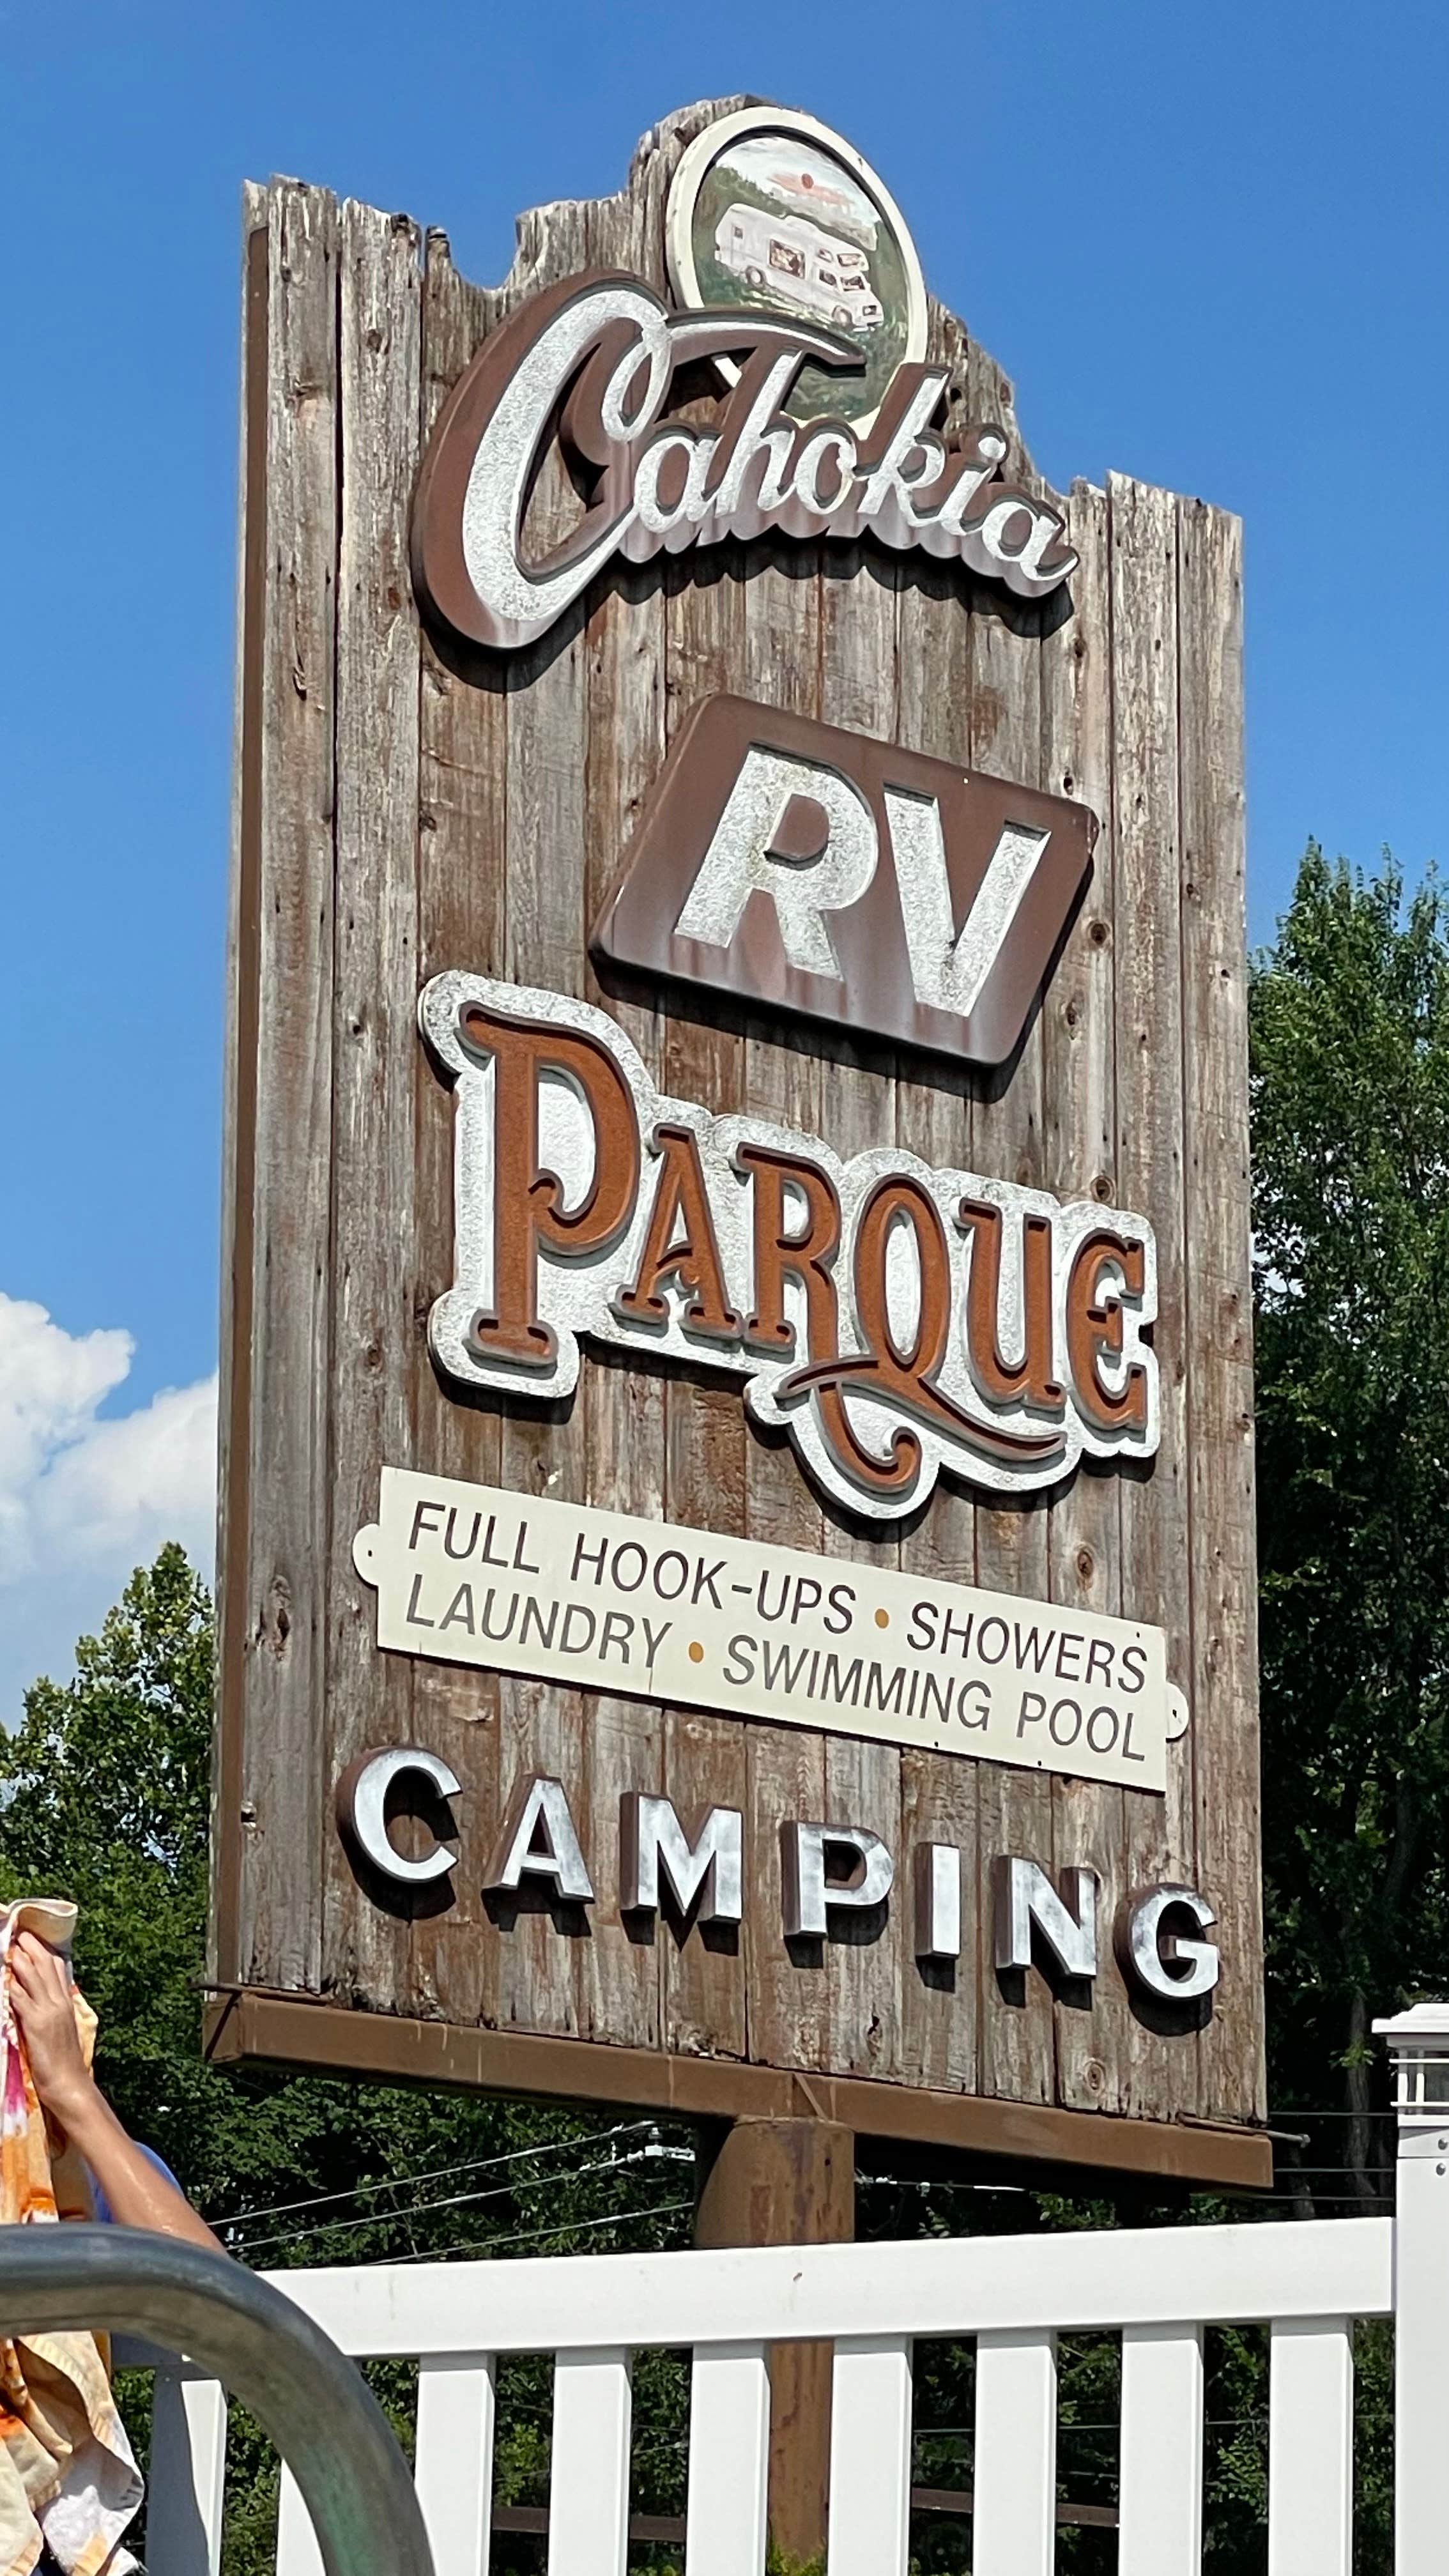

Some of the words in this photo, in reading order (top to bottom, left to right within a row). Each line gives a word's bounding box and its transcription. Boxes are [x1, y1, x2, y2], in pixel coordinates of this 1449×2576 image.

[461, 285, 1080, 622] Cahokia
[673, 741, 1053, 1017] RV
[457, 1000, 1146, 1489] PARQUE
[406, 1573, 673, 1668] LAUNDRY
[722, 1634, 992, 1731] SWIMMING
[1015, 1690, 1146, 1762] POOL
[408, 1500, 540, 1574] FULL
[570, 1532, 857, 1634] HOOK-UPS
[907, 1600, 1147, 1694] SHOWERS
[348, 1745, 1220, 2000] CAMPING
